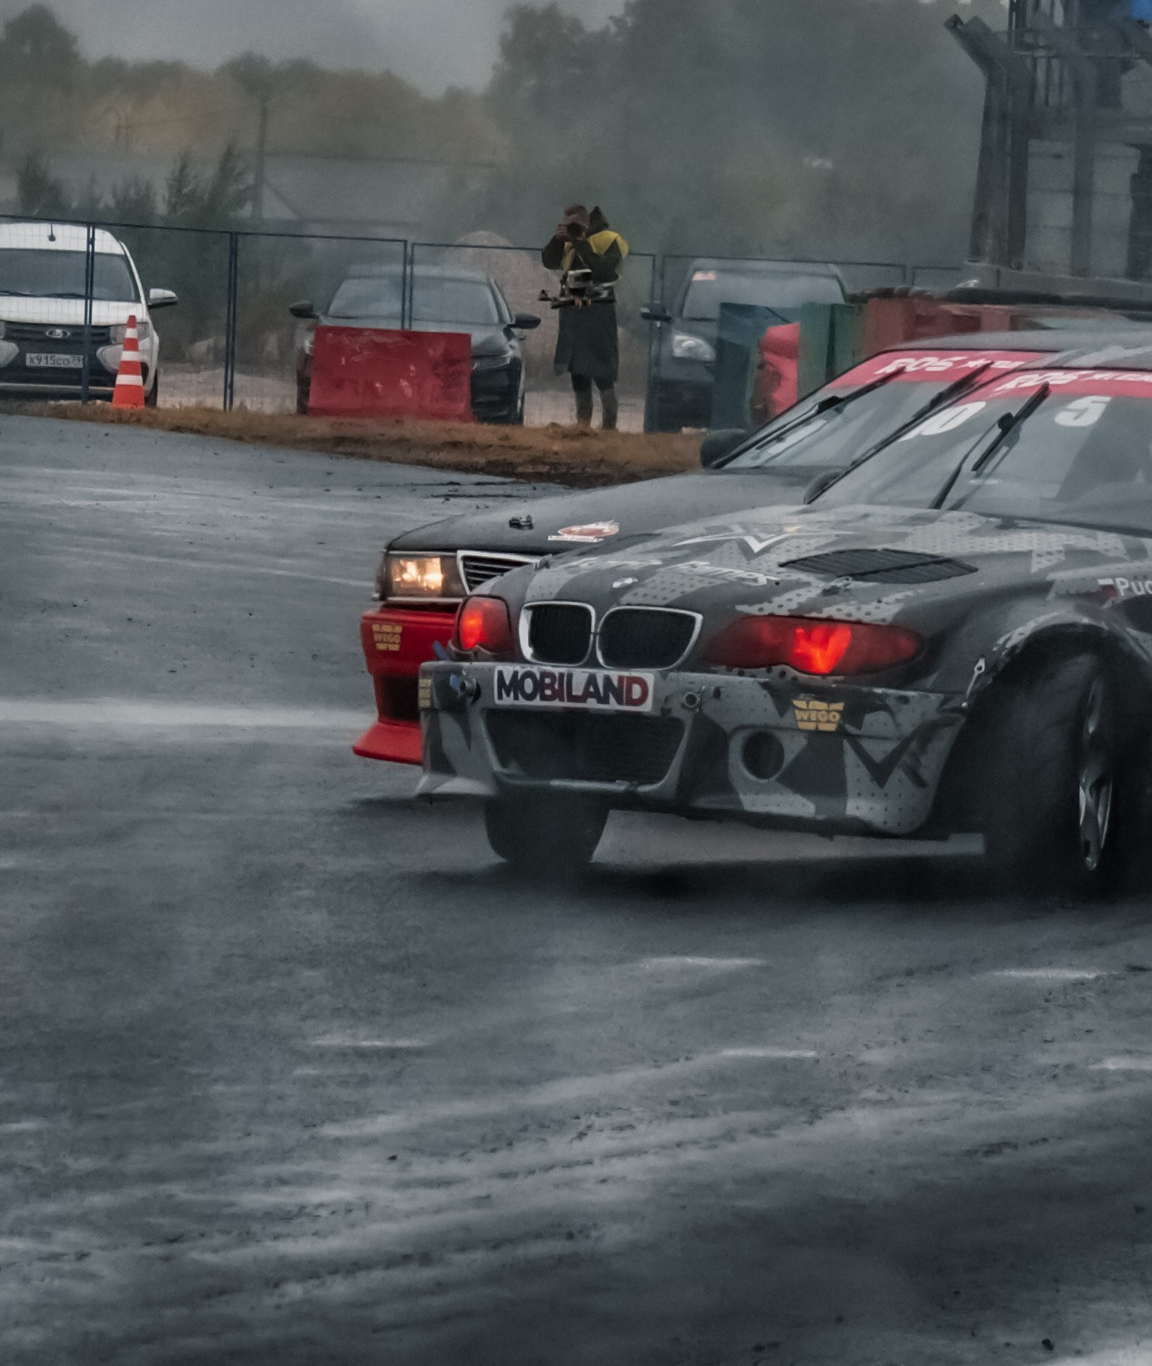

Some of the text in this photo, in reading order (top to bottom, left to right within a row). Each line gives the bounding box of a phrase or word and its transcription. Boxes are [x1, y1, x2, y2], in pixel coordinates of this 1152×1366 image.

[1054, 395, 1112, 427] 5
[496, 669, 649, 707] MOBILAND
[794, 709, 841, 723] WEGO
